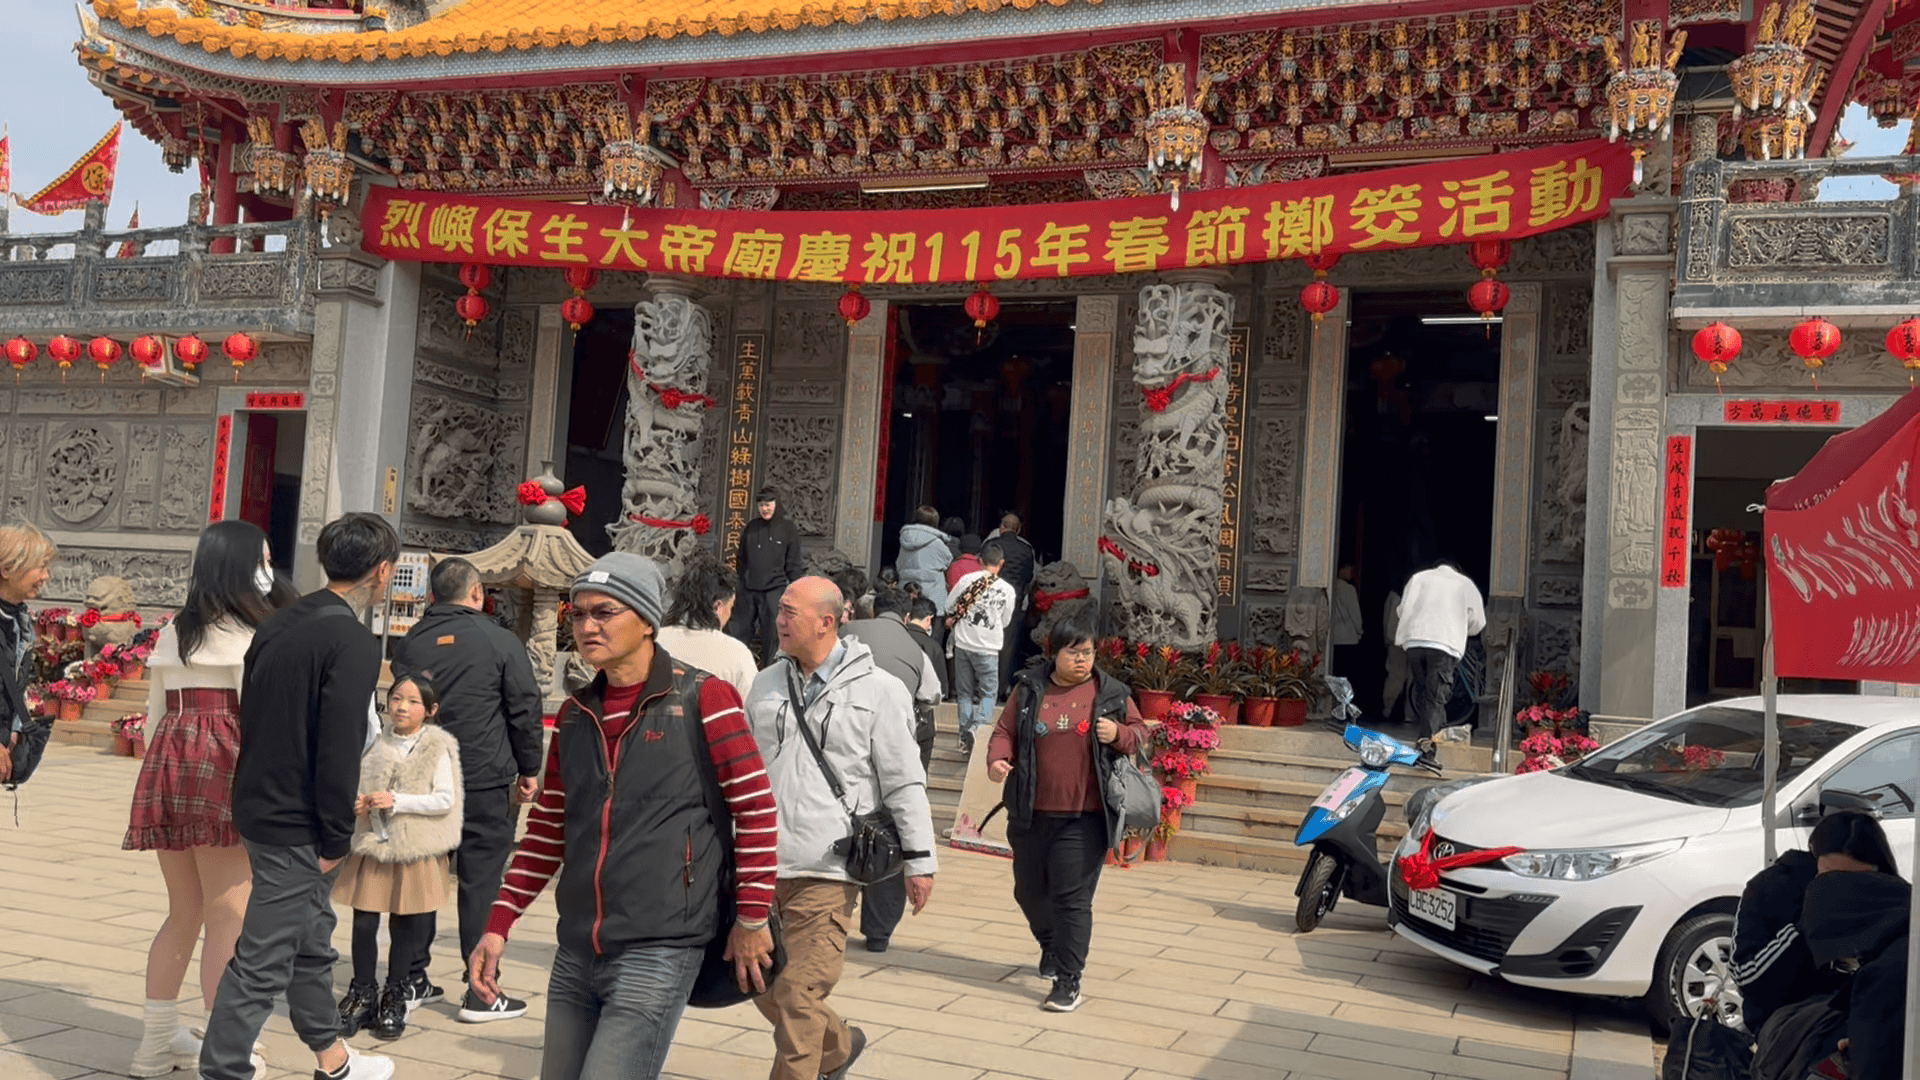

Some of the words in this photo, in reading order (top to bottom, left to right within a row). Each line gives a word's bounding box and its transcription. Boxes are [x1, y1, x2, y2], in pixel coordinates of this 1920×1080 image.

[380, 158, 1603, 283] 烈嶼保生大帝廟慶祝115年春節擲筊活動
